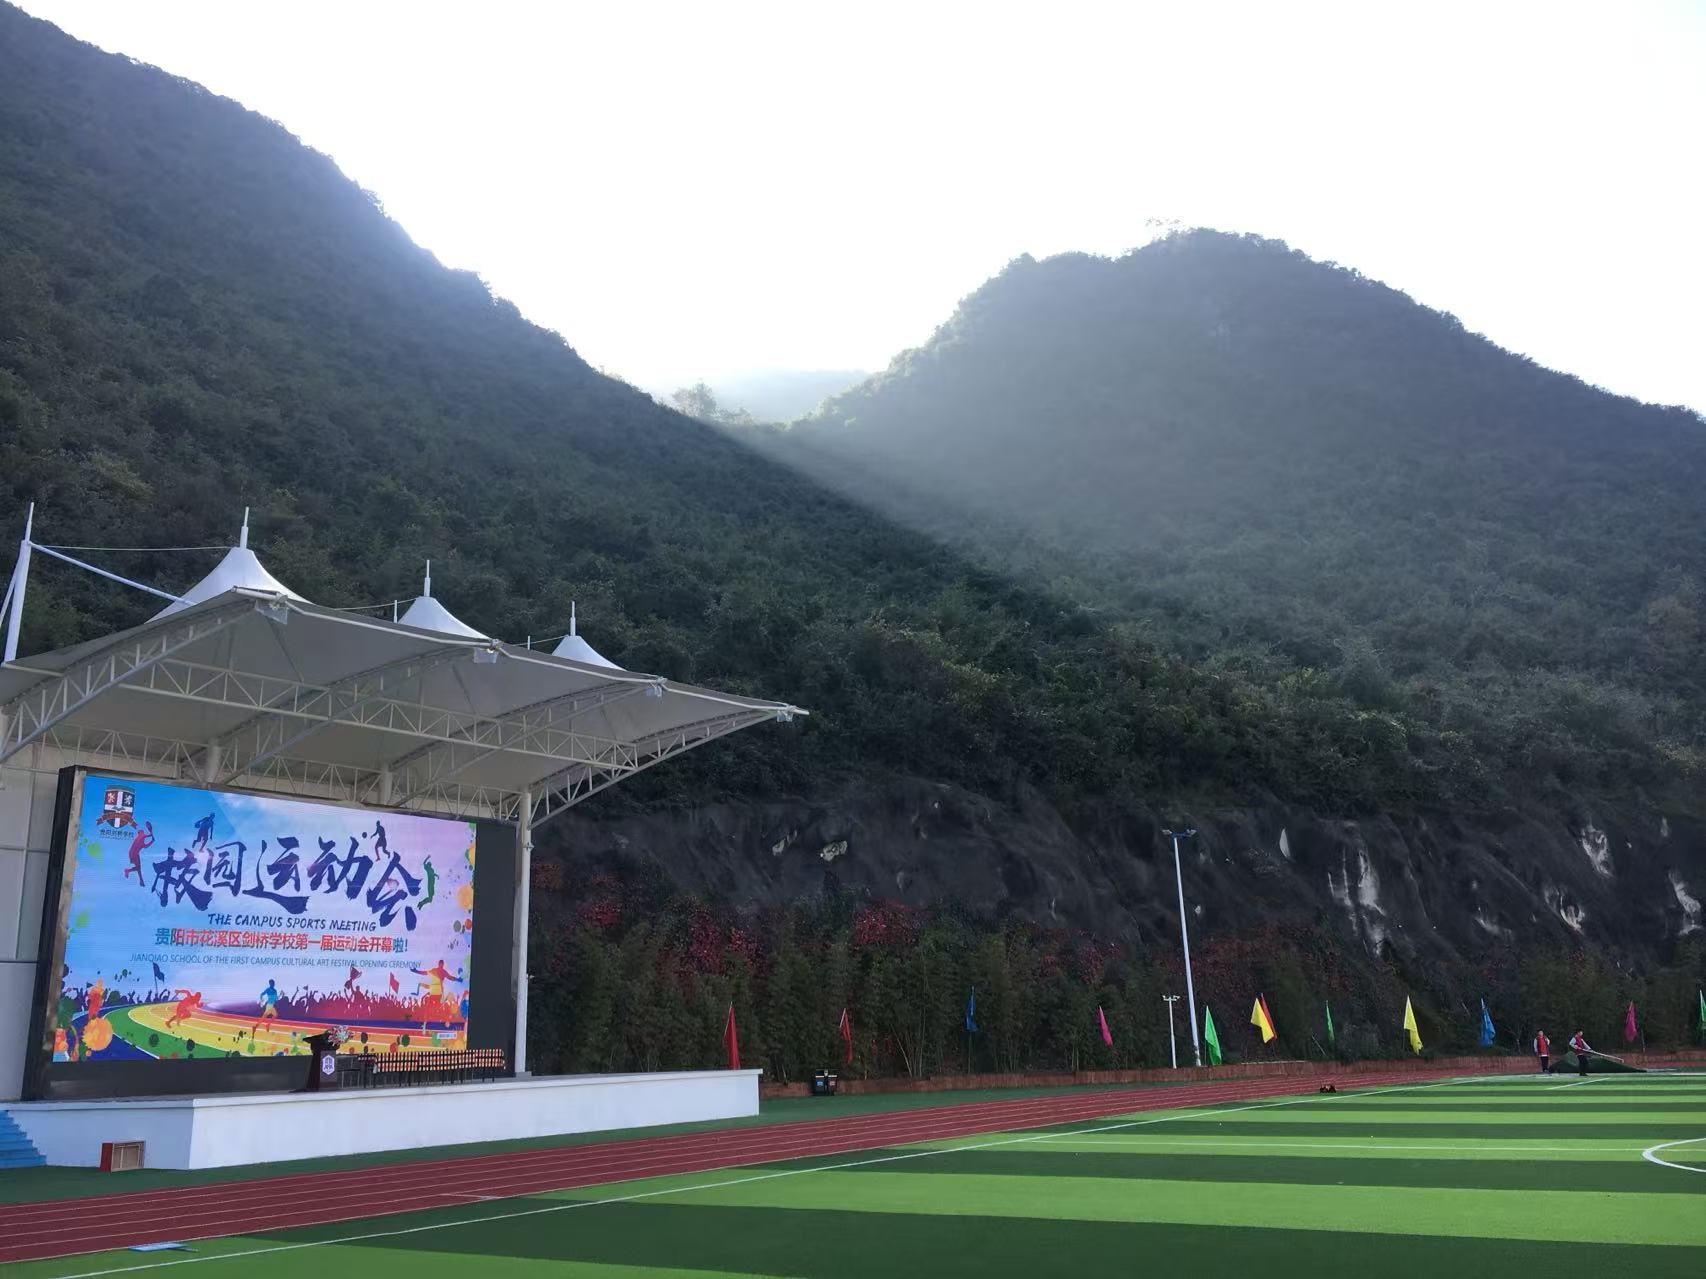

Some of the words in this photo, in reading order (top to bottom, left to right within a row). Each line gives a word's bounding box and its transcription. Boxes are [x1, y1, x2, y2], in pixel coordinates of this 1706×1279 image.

[151, 836, 421, 931] 校园运动会
[208, 913, 232, 926] THE
[235, 914, 283, 928] CAMPUS
[286, 917, 326, 930] SPORTS
[329, 919, 377, 932] MEETING
[130, 953, 168, 963] JIANQIAO
[170, 954, 201, 963] SCHOOL
[203, 955, 212, 964] OF
[216, 955, 229, 964] THE
[231, 956, 249, 965] FIRST
[251, 957, 281, 966] CAMPUS
[282, 958, 315, 967] CULTURAL
[317, 959, 330, 967] ART
[331, 959, 358, 968] FESTIVAL
[360, 960, 388, 968] OPENING
[389, 960, 422, 969] CEREMONY
